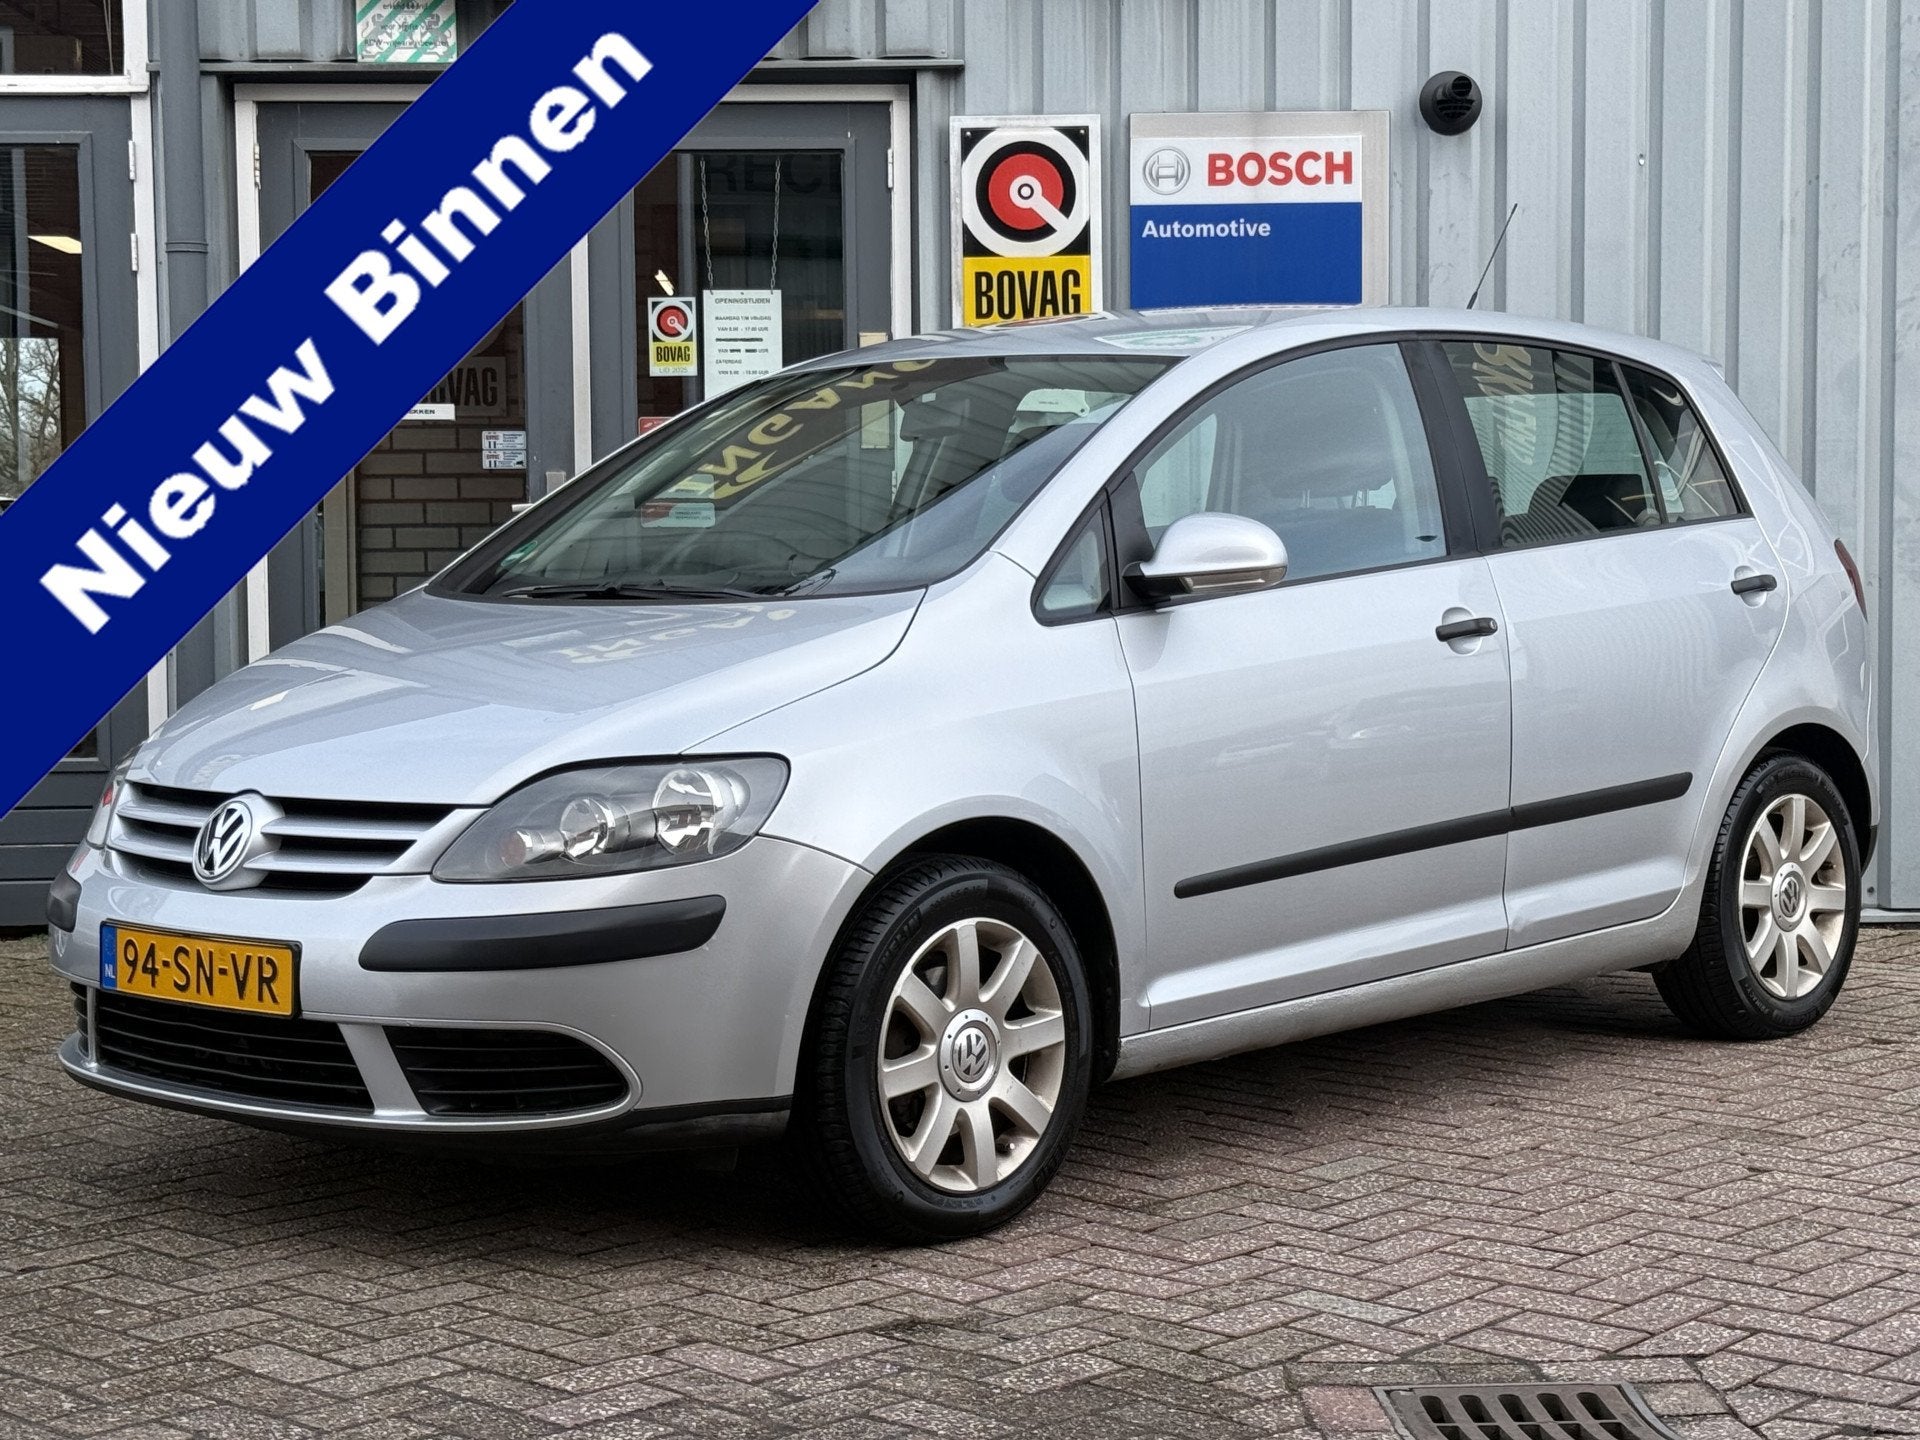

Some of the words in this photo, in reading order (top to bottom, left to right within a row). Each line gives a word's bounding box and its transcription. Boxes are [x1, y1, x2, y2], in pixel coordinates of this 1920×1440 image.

[1207, 151, 1353, 187] BOSCH
[1141, 217, 1271, 239] Automotive
[975, 269, 1081, 320] BOVAG
[656, 346, 691, 363] BOVAG
[104, 963, 115, 979] NL
[123, 938, 280, 1005] 94-SN-VR
